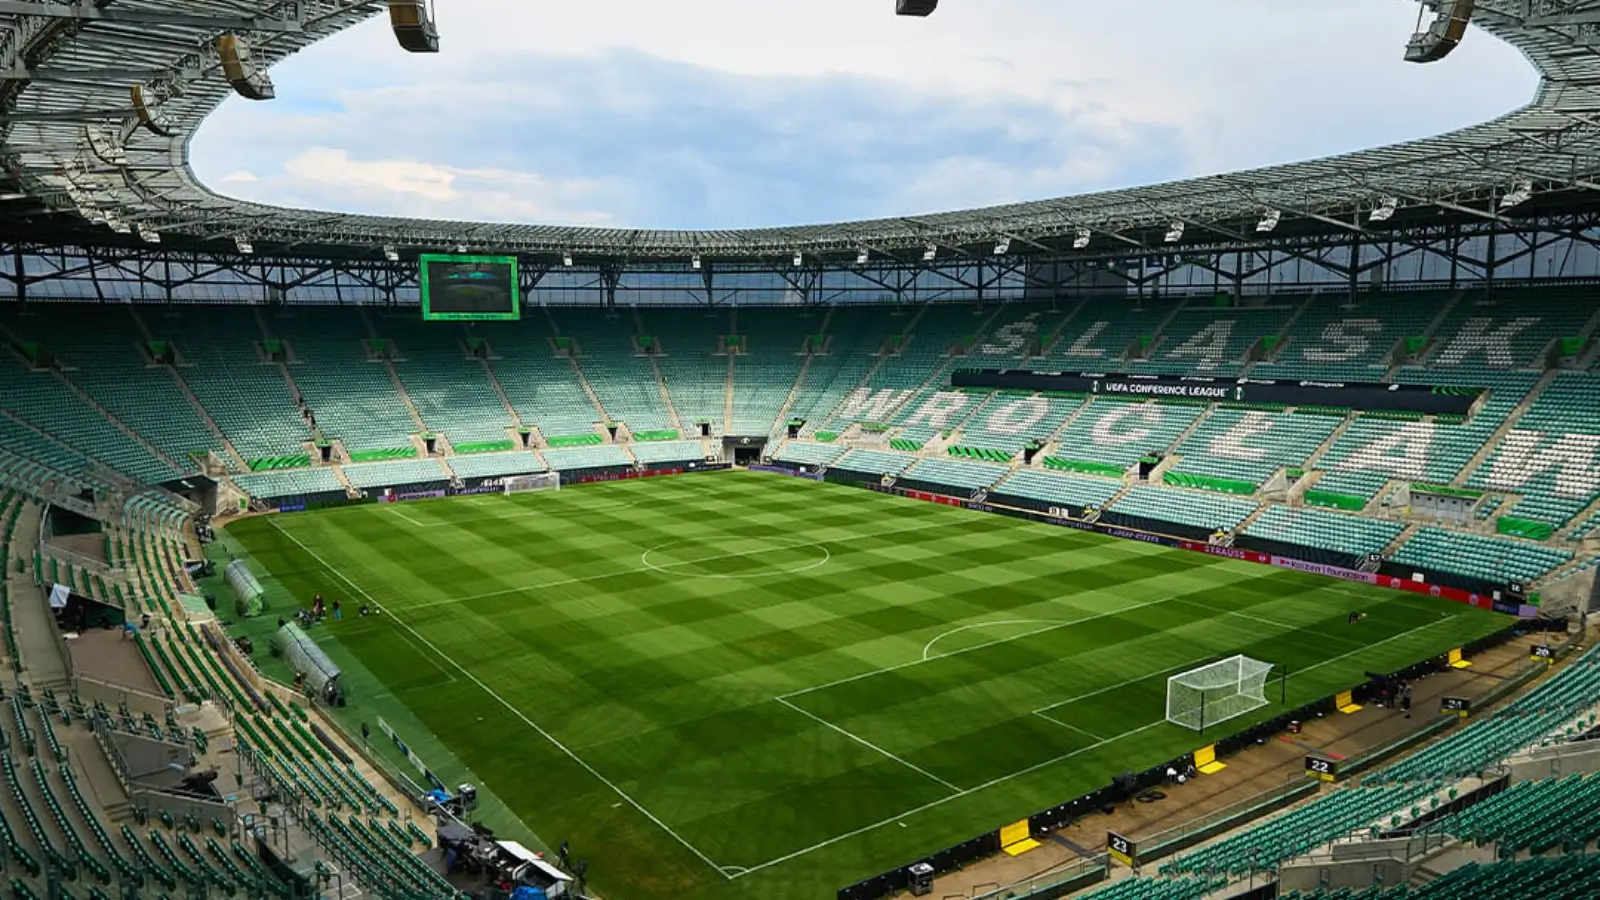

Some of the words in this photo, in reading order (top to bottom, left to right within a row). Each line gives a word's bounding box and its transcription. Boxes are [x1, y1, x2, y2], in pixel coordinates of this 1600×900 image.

[1106, 382, 1128, 392] UEFA
[1129, 383, 1187, 395] CONFERENCE
[1189, 385, 1226, 397] LEAGUE
[1311, 759, 1329, 773] 22
[1112, 837, 1128, 853] 23
